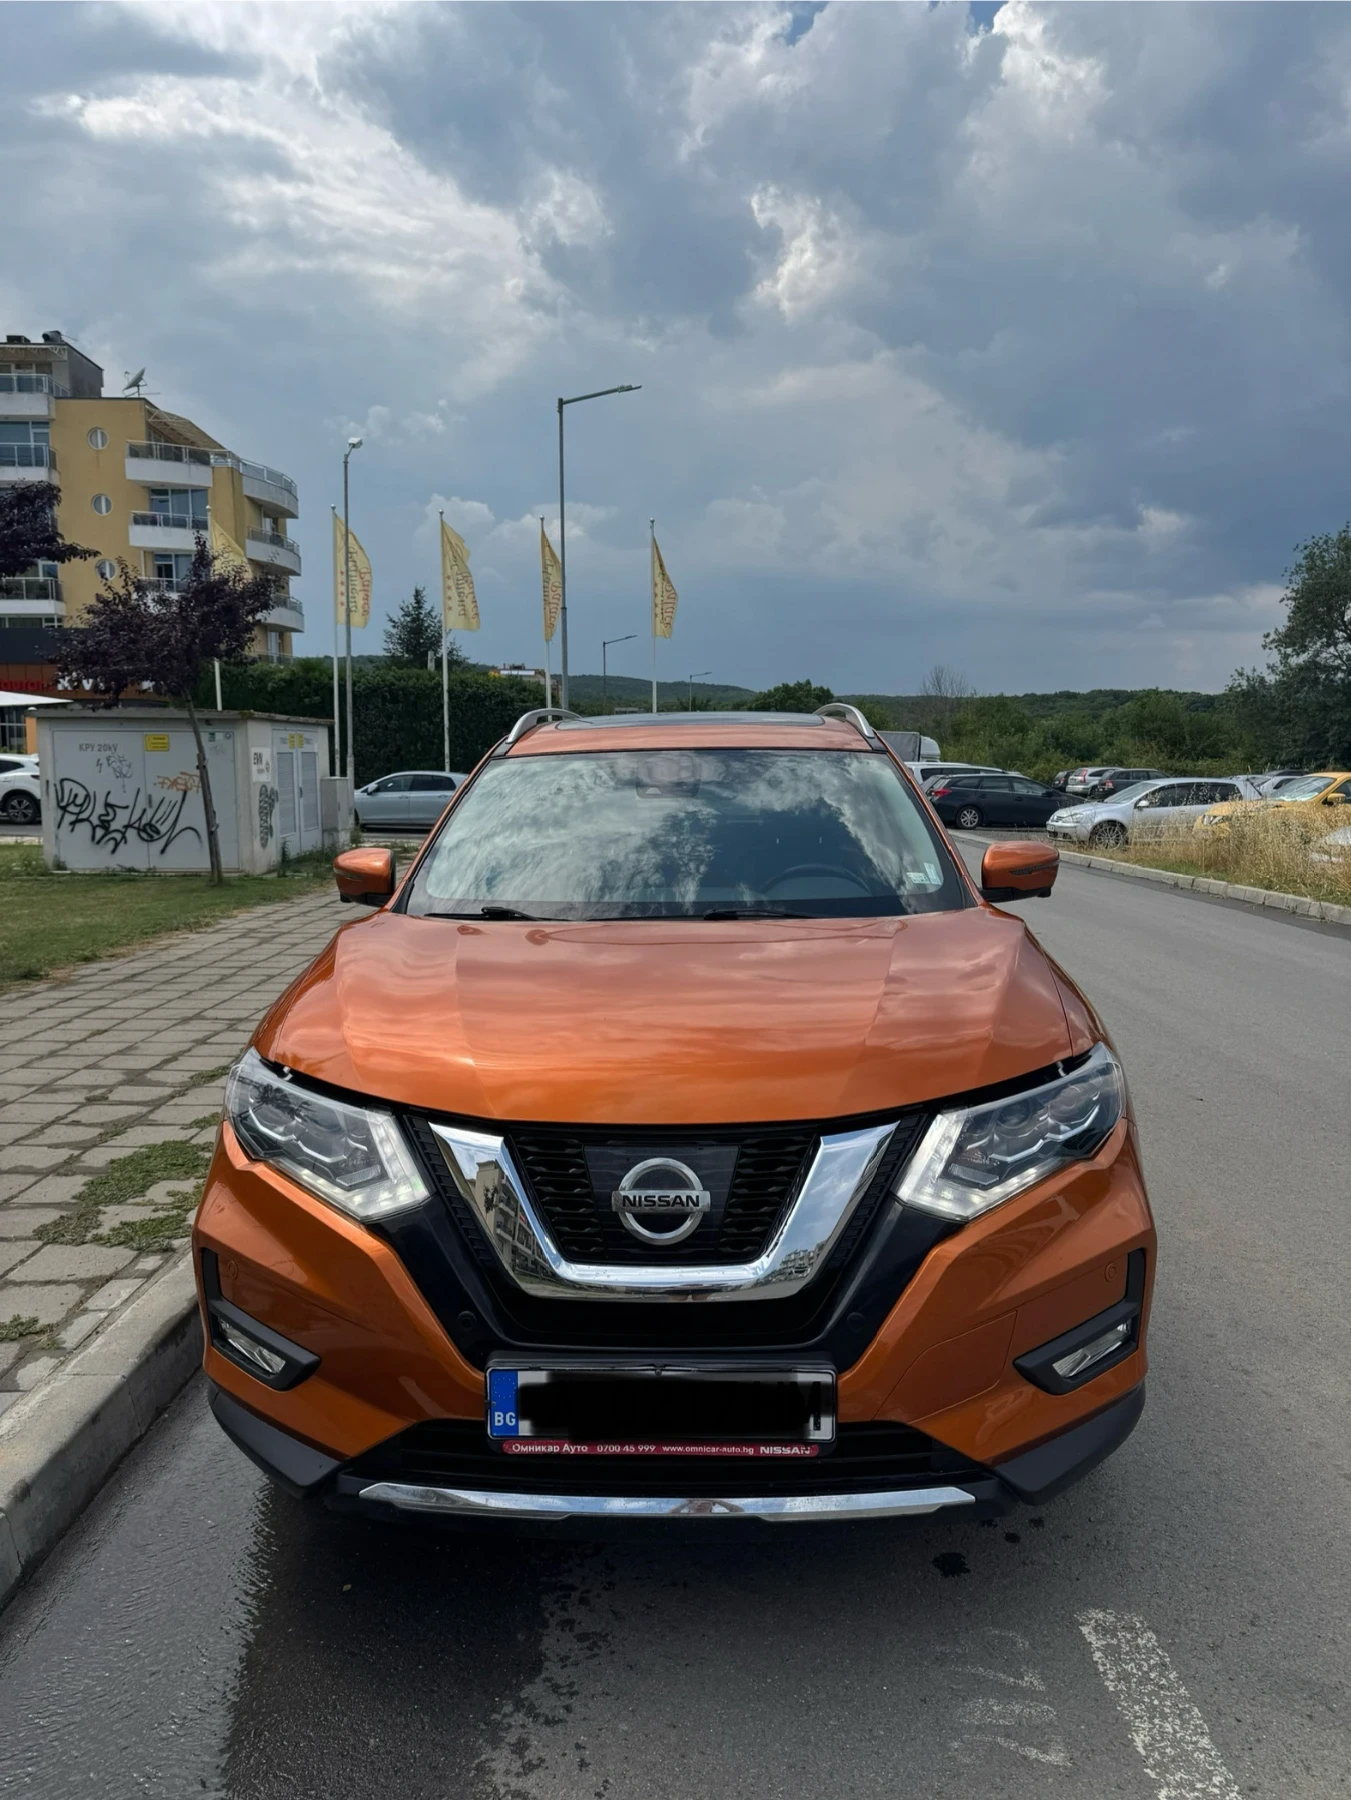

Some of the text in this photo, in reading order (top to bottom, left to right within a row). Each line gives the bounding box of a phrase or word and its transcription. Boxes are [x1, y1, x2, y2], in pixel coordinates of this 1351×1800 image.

[253, 752, 263, 766] EVN
[622, 1195, 700, 1208] NISSAN
[494, 1411, 516, 1427] BG
[512, 1443, 560, 1454] Омникар
[562, 1443, 588, 1454] Ауто
[597, 1444, 620, 1453] 0700
[638, 1444, 656, 1453] 999
[662, 1444, 755, 1455] www.omnicar-auto.bg
[760, 1445, 811, 1455] NISSAN
